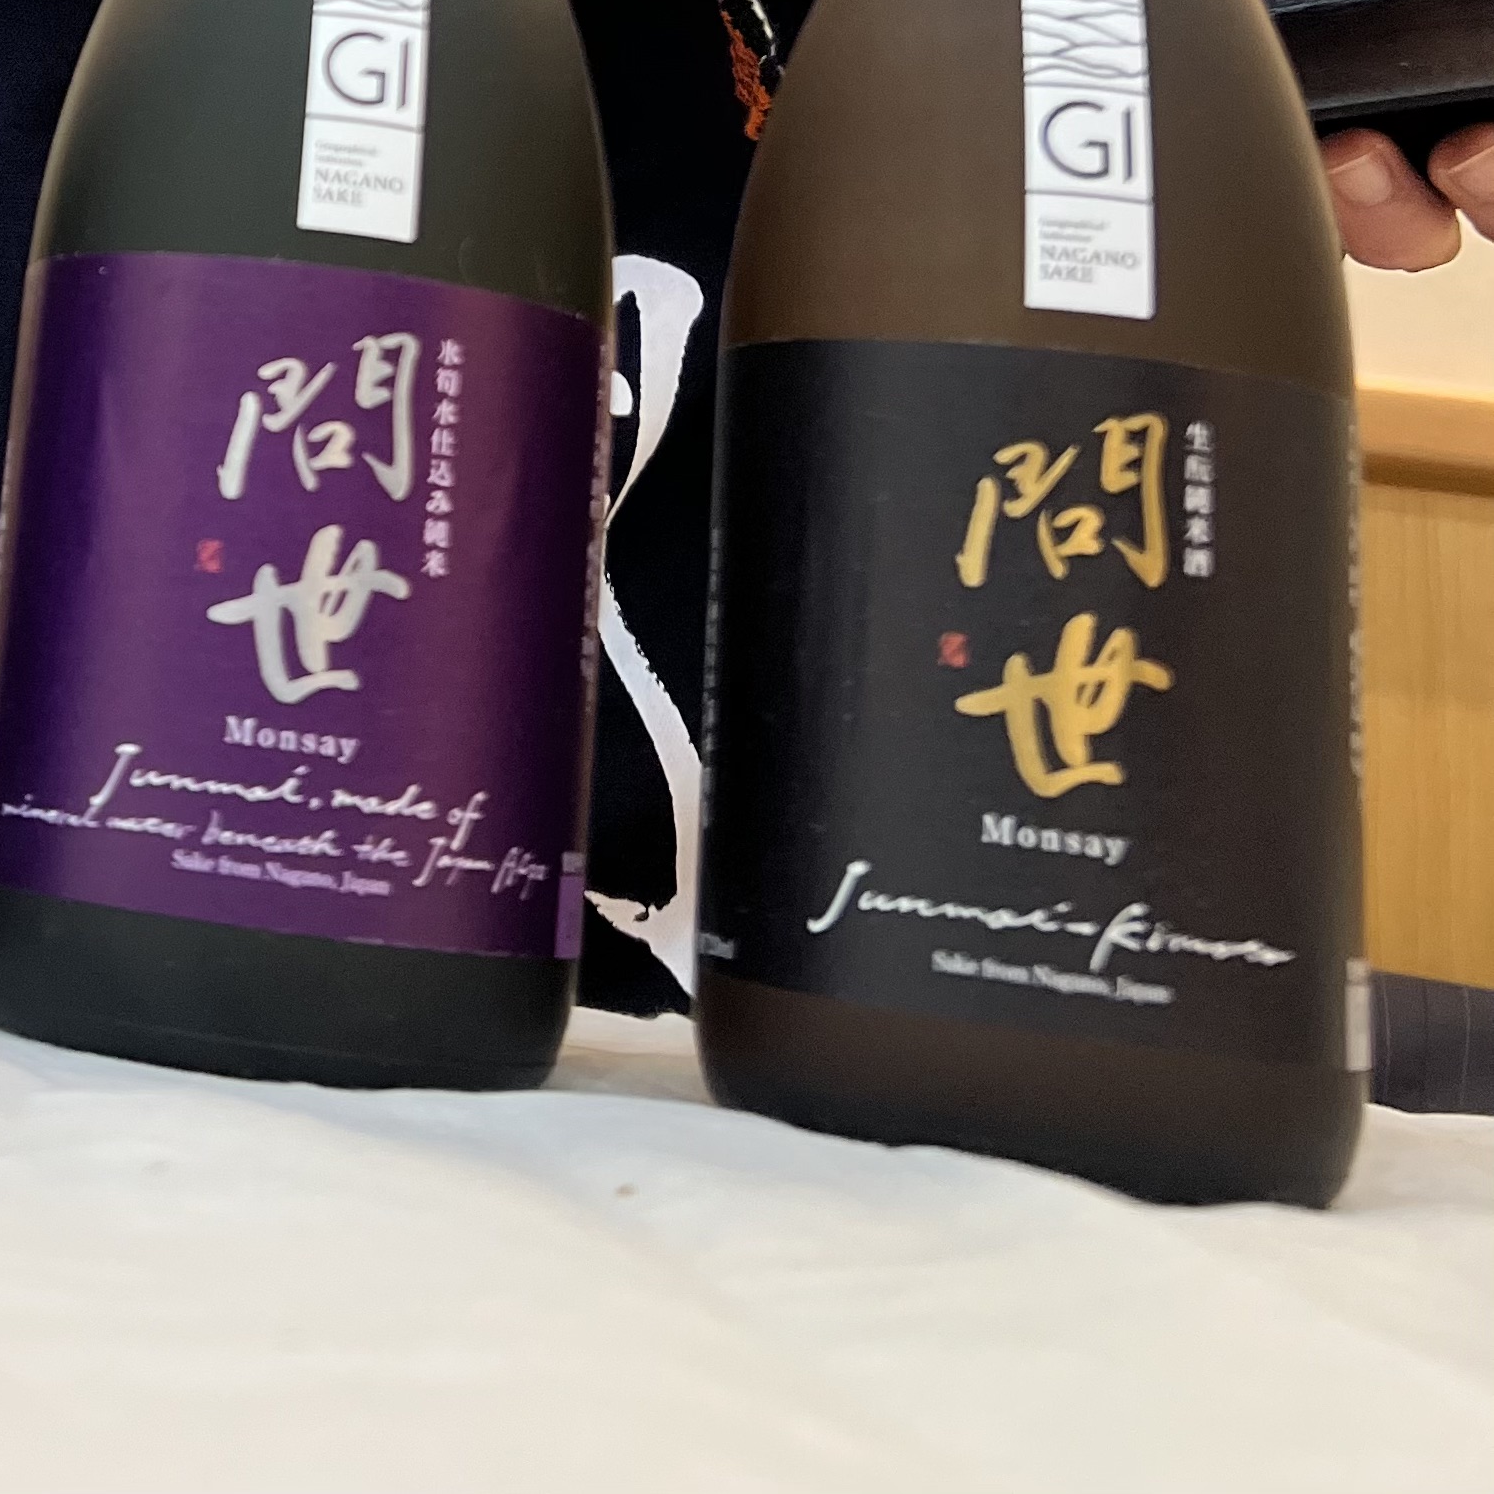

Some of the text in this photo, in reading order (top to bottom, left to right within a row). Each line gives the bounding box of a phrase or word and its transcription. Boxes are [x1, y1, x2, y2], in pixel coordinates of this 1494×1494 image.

[322, 31, 411, 111] GI
[1039, 100, 1134, 184] GI
[312, 187, 363, 207] SAKE
[314, 167, 404, 194] NAGANO
[1038, 244, 1139, 270] NAGANO
[1038, 263, 1094, 282] SAKE
[224, 715, 360, 764] Monsay
[201, 810, 343, 856] beneath
[351, 836, 410, 867] the
[330, 783, 440, 820] made
[447, 791, 487, 852] of
[981, 811, 1131, 866] Monsay
